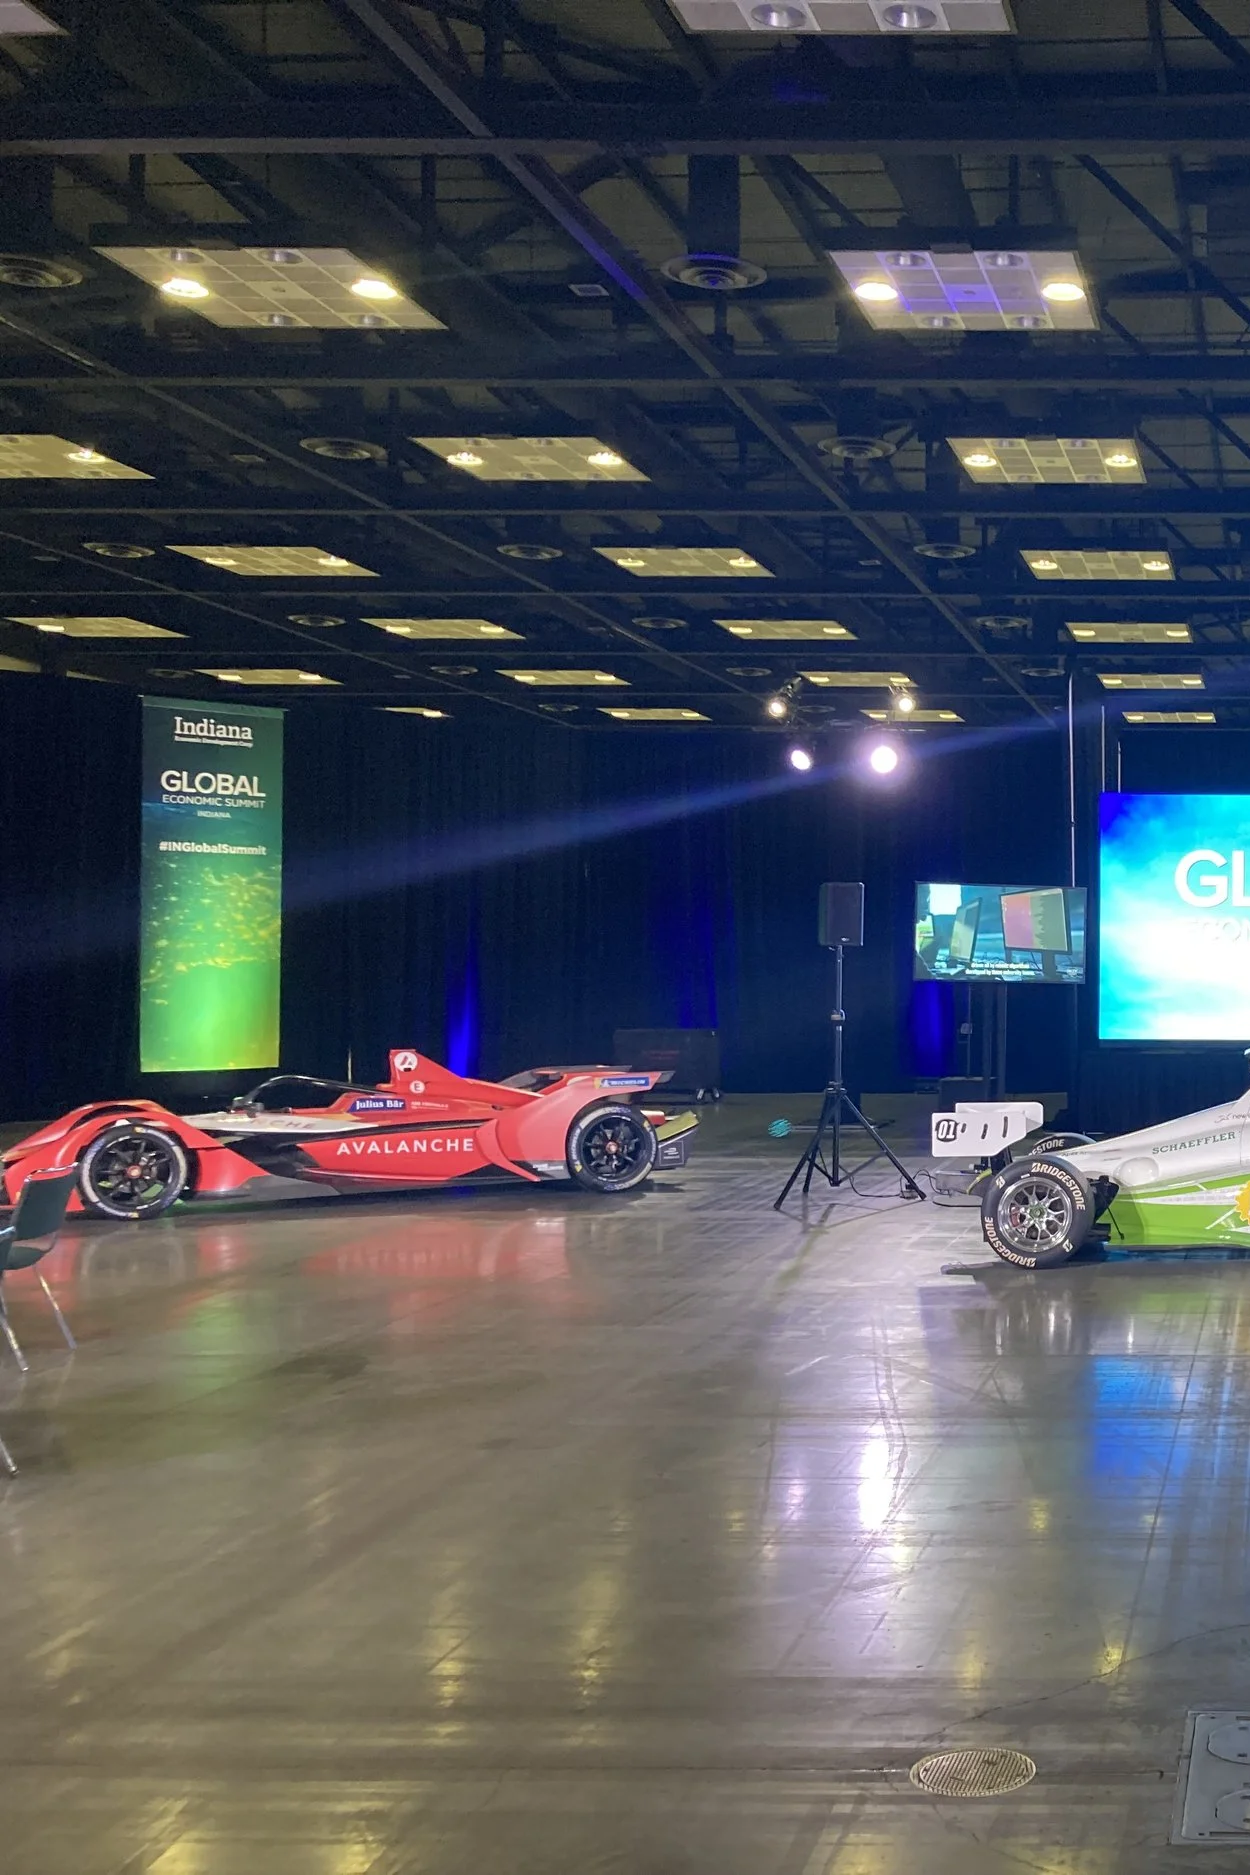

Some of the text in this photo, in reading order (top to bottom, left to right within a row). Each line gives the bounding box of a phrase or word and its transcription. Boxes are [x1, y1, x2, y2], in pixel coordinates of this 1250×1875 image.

[174, 716, 253, 740] Indiana
[161, 770, 266, 797] GLOBAL
[162, 794, 266, 809] ECONOMIC SUMMIT
[159, 841, 267, 856] #INGlobalSummit
[356, 1100, 384, 1110] Julius
[938, 1120, 956, 1139] 01
[336, 1138, 475, 1154] AVALANCHE
[1152, 1131, 1236, 1155] SCHAEFFLER
[1031, 1162, 1086, 1211] BRIDGESTONE
[985, 1216, 1037, 1267] BRIDGESTONE
